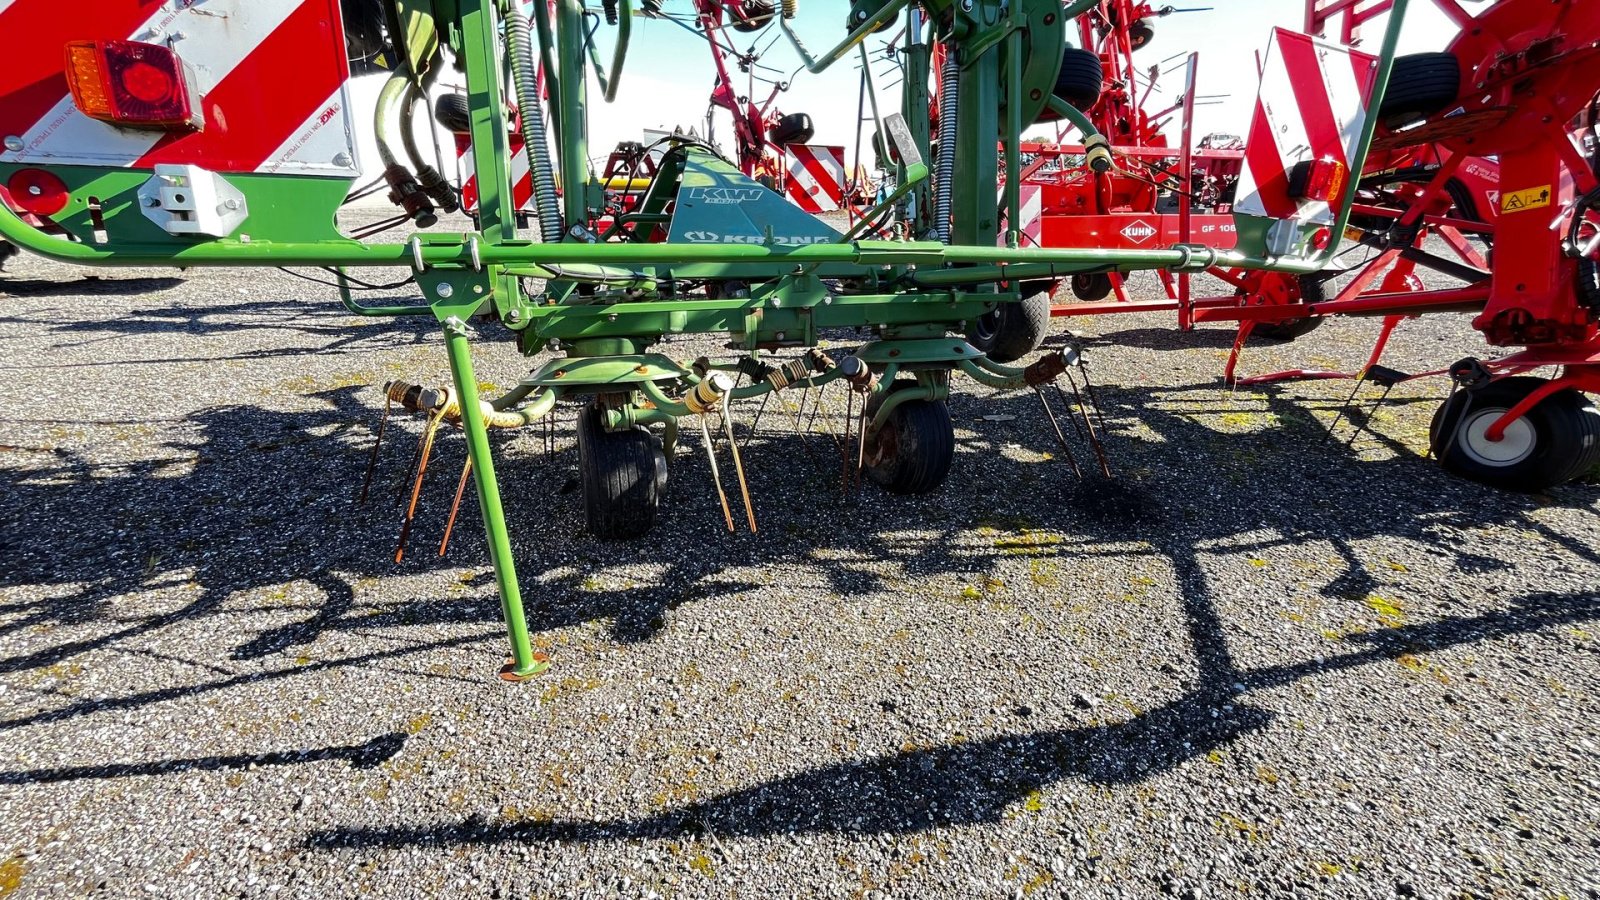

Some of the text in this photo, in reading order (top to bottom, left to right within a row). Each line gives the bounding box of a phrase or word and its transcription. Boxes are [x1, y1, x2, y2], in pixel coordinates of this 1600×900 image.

[320, 107, 336, 126] WGF
[690, 187, 763, 201] KW
[1125, 227, 1152, 237] KUHN
[1201, 225, 1216, 233] GF
